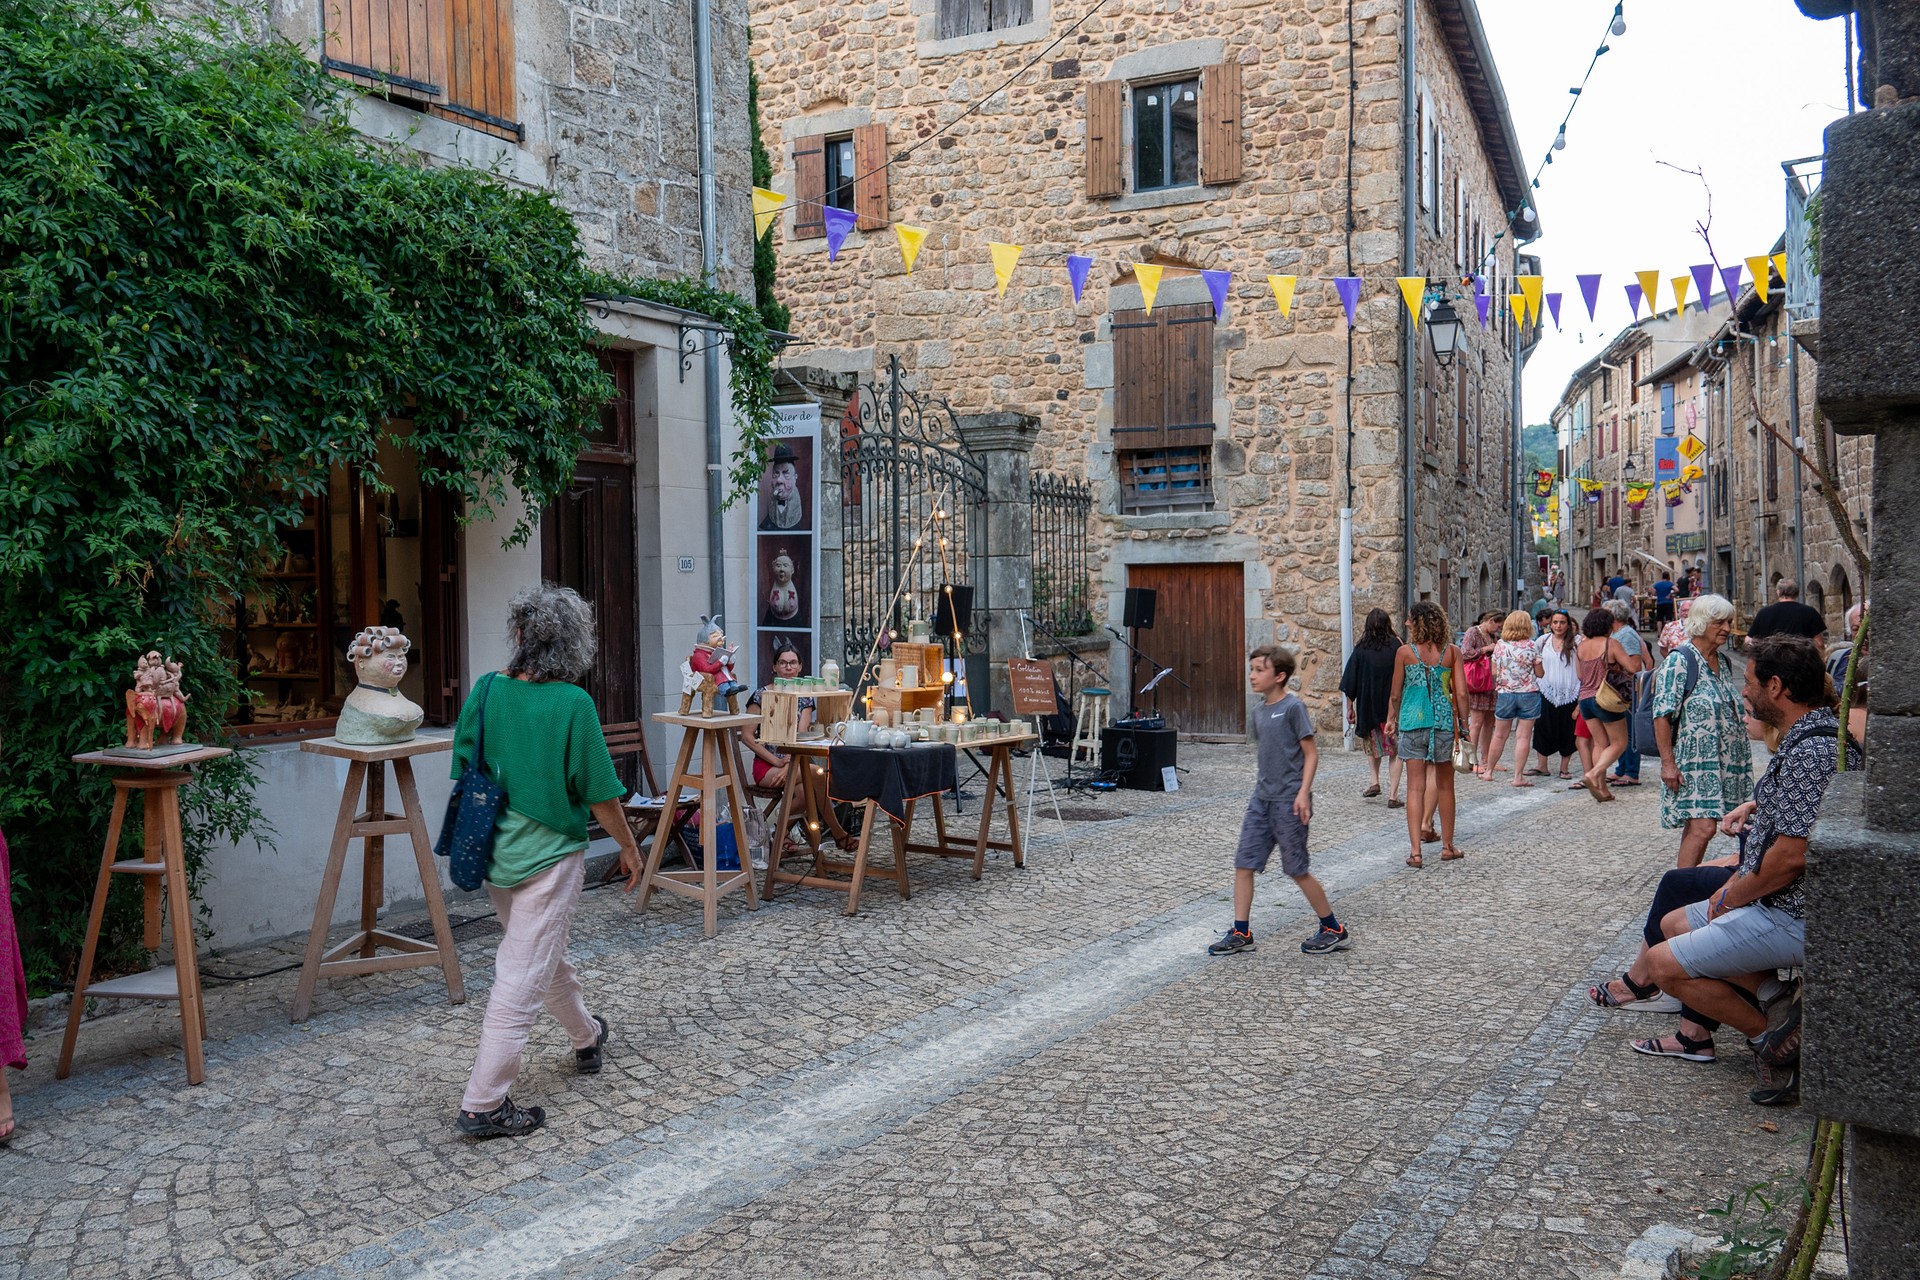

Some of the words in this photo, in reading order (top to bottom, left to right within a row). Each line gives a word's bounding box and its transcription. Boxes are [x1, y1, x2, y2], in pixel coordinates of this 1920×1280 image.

[800, 410, 813, 421] de
[776, 425, 795, 435] BOB
[680, 559, 693, 569] 105
